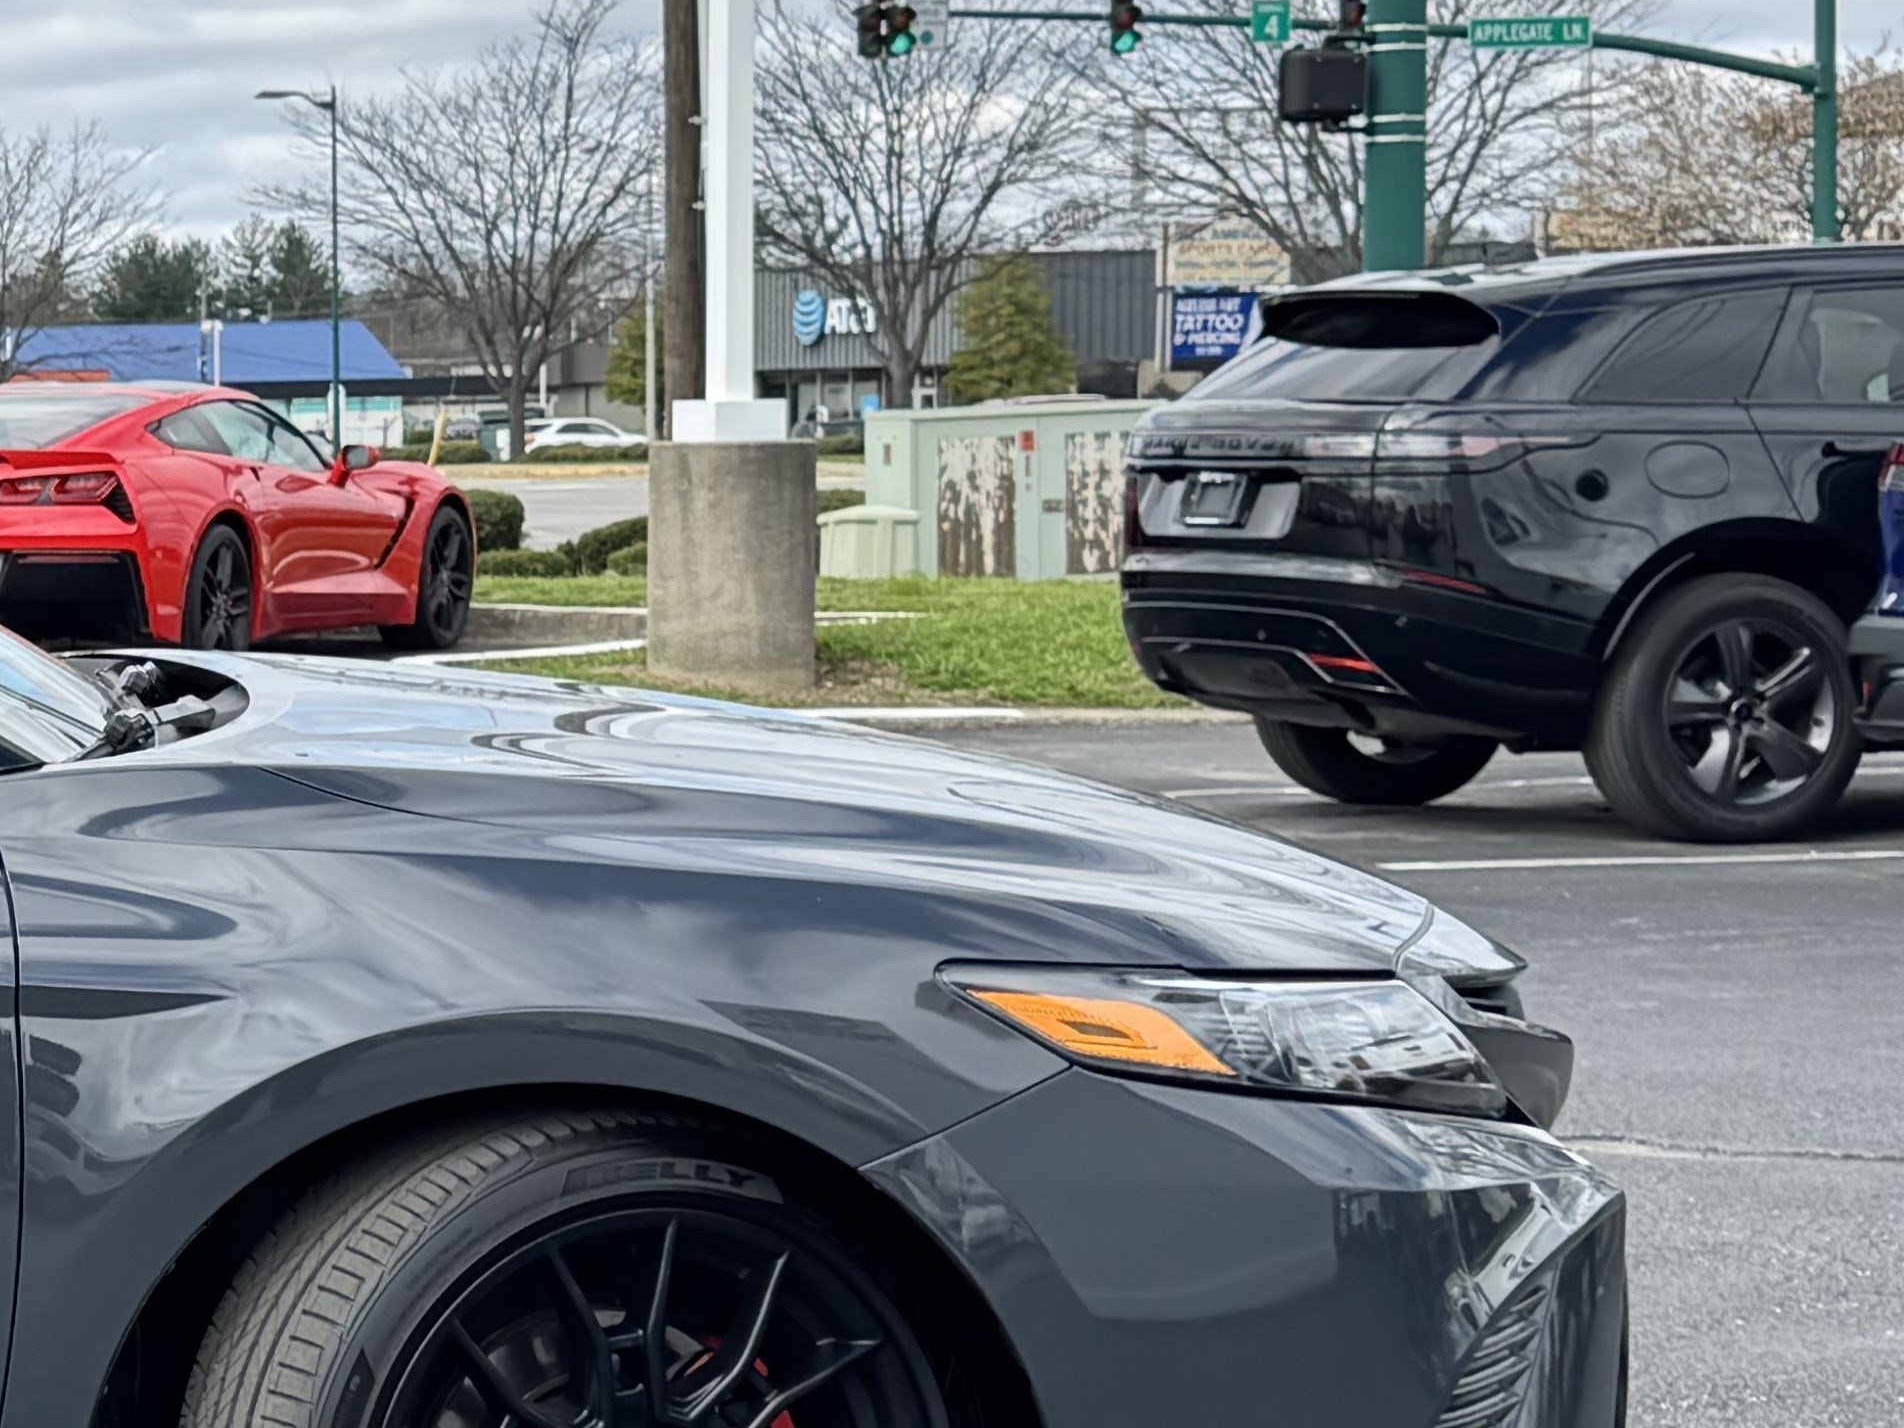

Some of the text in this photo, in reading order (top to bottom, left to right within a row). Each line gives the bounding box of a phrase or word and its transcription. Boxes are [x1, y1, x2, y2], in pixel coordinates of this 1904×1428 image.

[1264, 15, 1279, 38] 4
[1474, 23, 1553, 41] APPLEGATE
[1175, 314, 1244, 332] TATTOO
